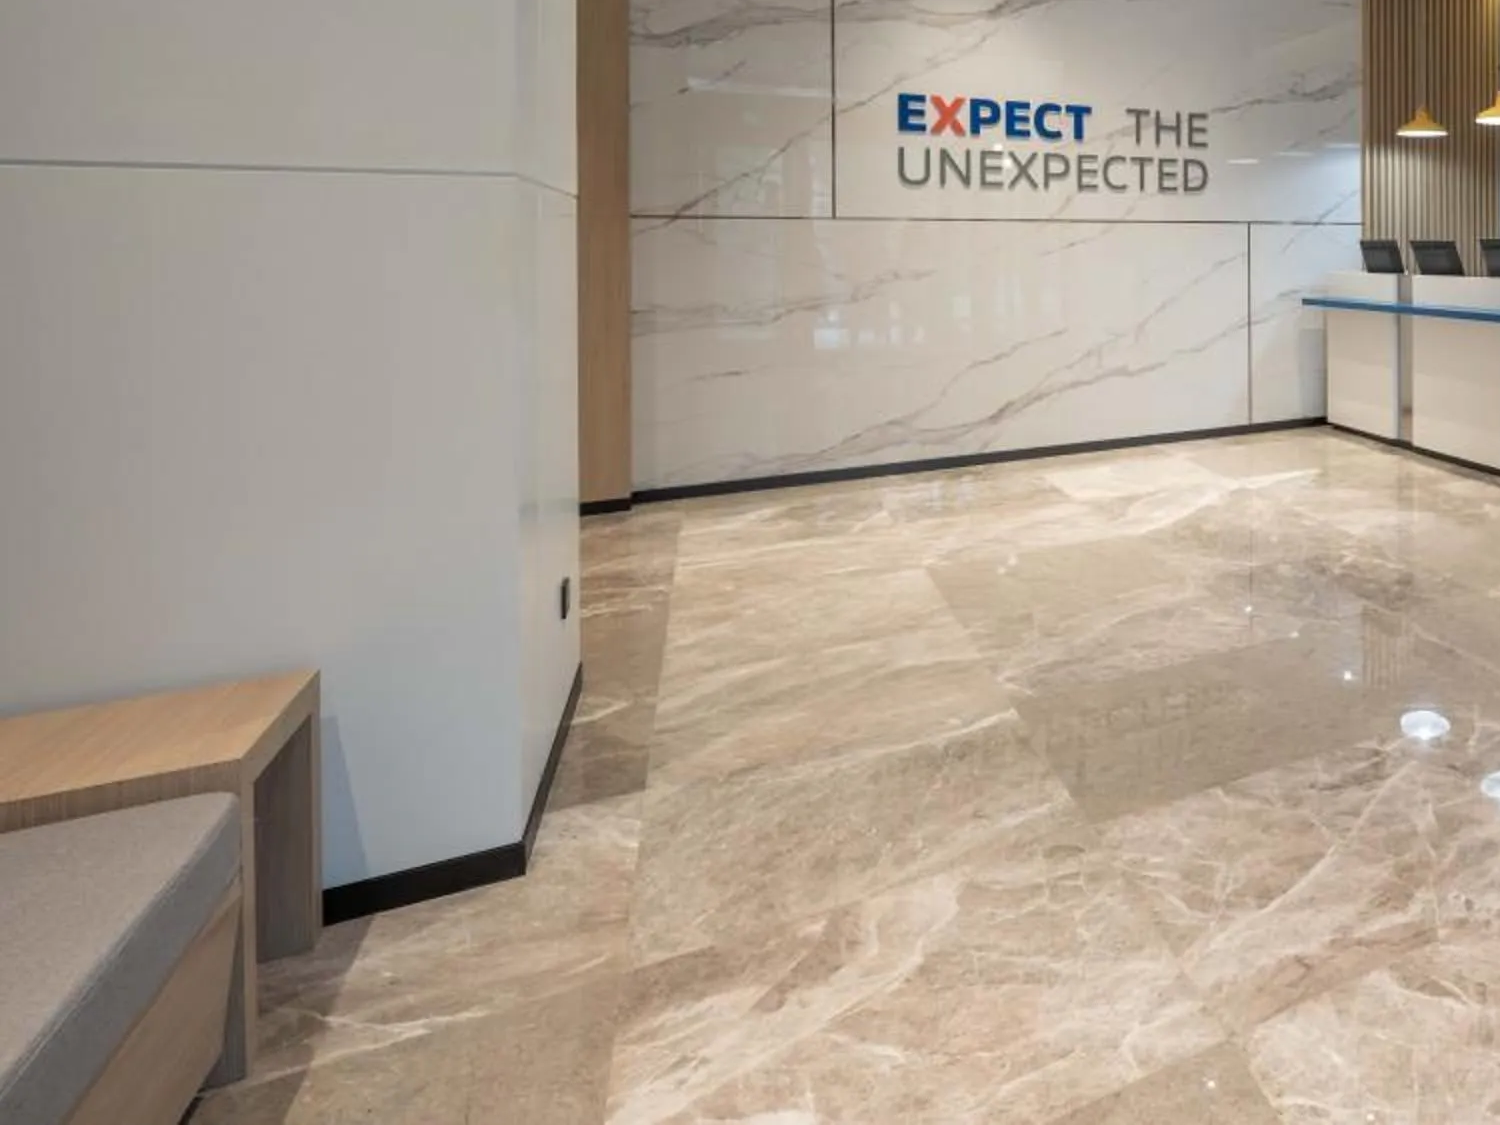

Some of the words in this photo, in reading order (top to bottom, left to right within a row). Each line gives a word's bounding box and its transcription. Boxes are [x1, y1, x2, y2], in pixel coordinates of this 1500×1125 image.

[897, 93, 1093, 144] EXPECT
[1126, 108, 1209, 149] THE
[897, 146, 1209, 193] UNEXPECTED
